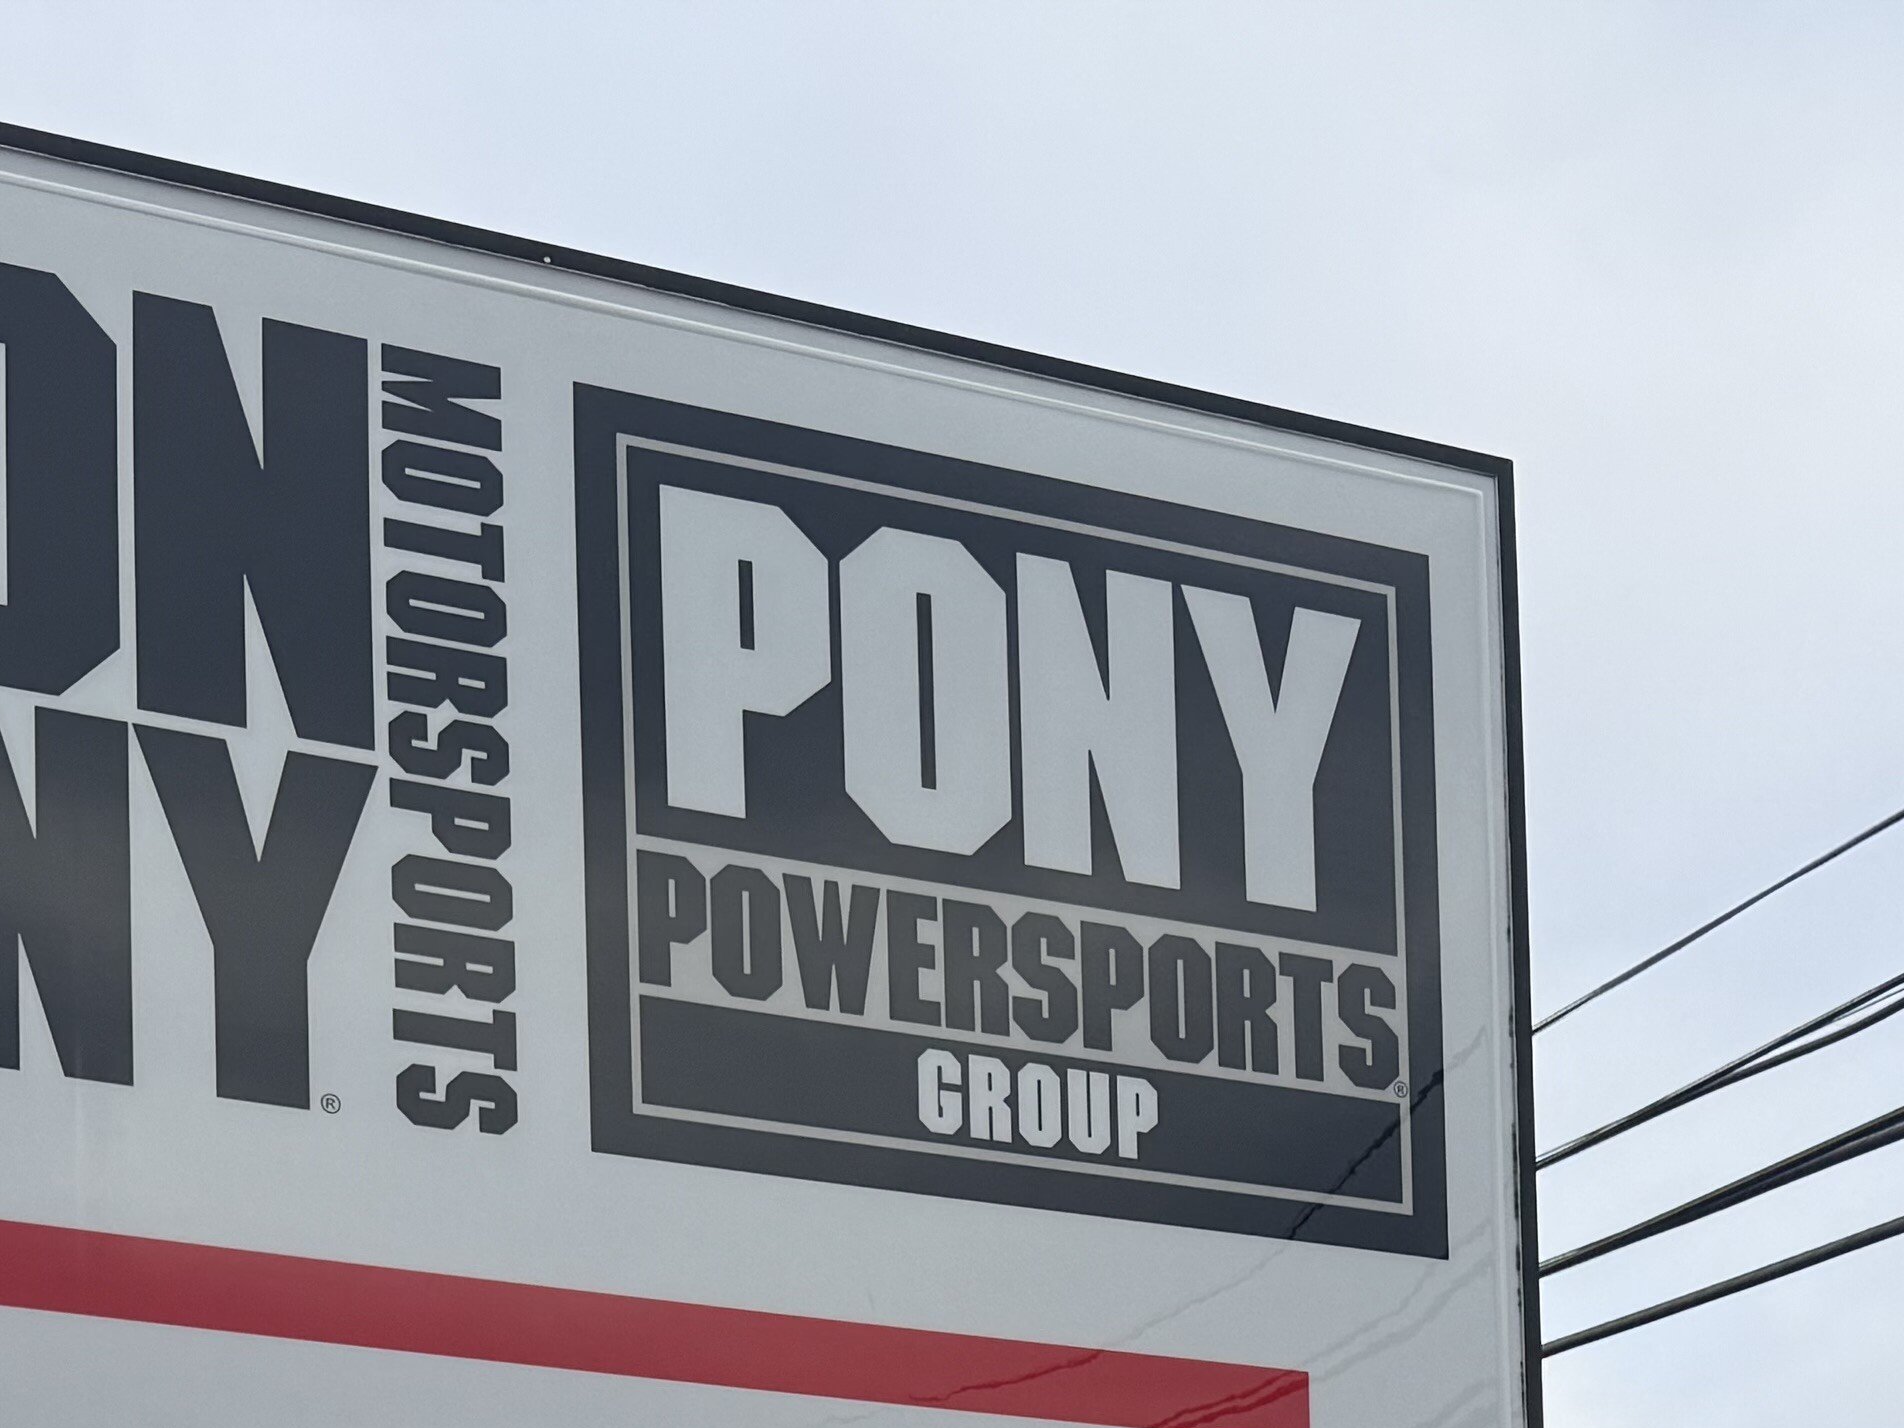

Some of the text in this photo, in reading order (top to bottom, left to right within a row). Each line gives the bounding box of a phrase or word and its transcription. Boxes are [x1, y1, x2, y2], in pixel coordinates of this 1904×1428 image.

[381, 342, 518, 1135] MOTORSPORTS
[659, 484, 1362, 913] PONY
[636, 848, 1400, 1091] POWERSPORTS
[916, 1047, 1159, 1160] GROUP
